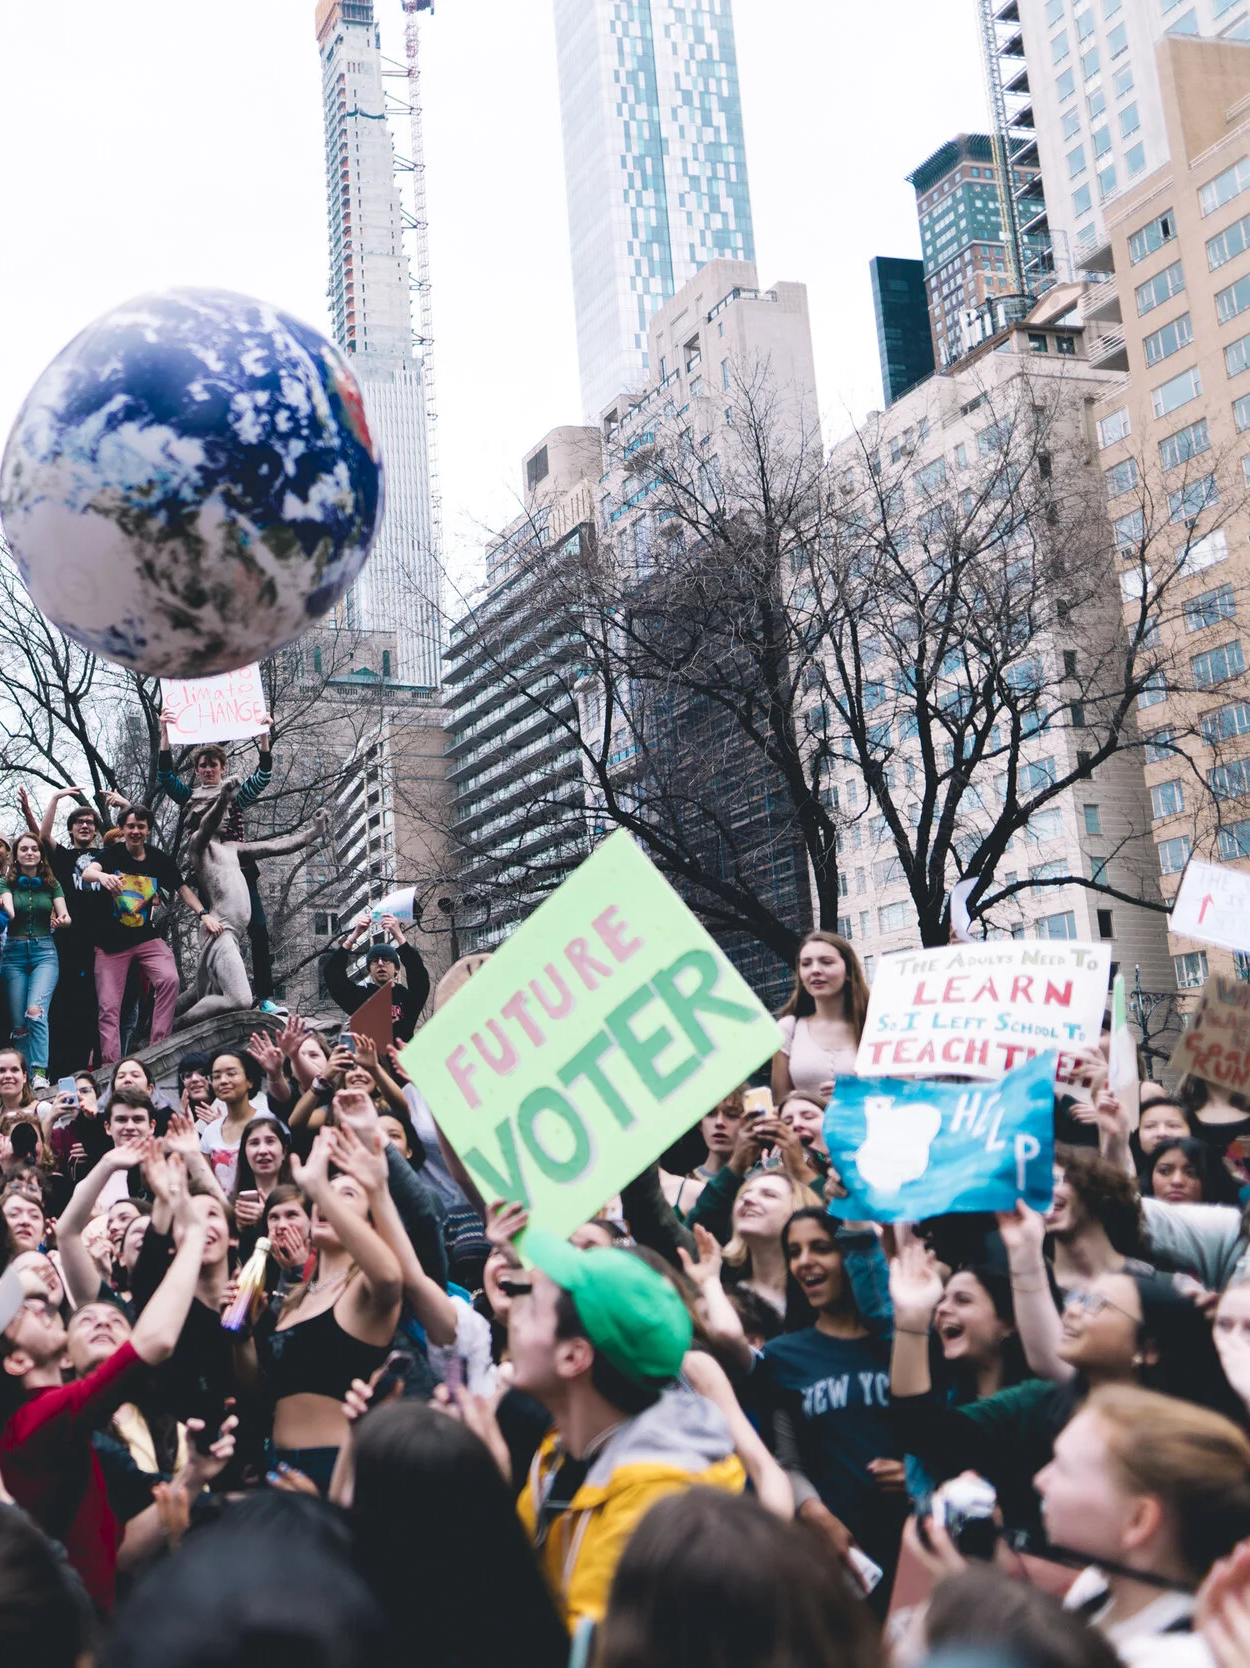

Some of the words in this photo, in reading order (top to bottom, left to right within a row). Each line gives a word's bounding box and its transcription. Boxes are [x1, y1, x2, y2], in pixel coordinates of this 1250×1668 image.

[175, 698, 263, 735] CHANGE
[1197, 866, 1233, 891] THE
[444, 903, 646, 1112] FUTURE
[912, 974, 1074, 1009] LEARN
[900, 1010, 921, 1033] I
[867, 1037, 991, 1066] TEACH
[462, 948, 762, 1211] VOTER
[949, 1091, 1042, 1192] HELP
